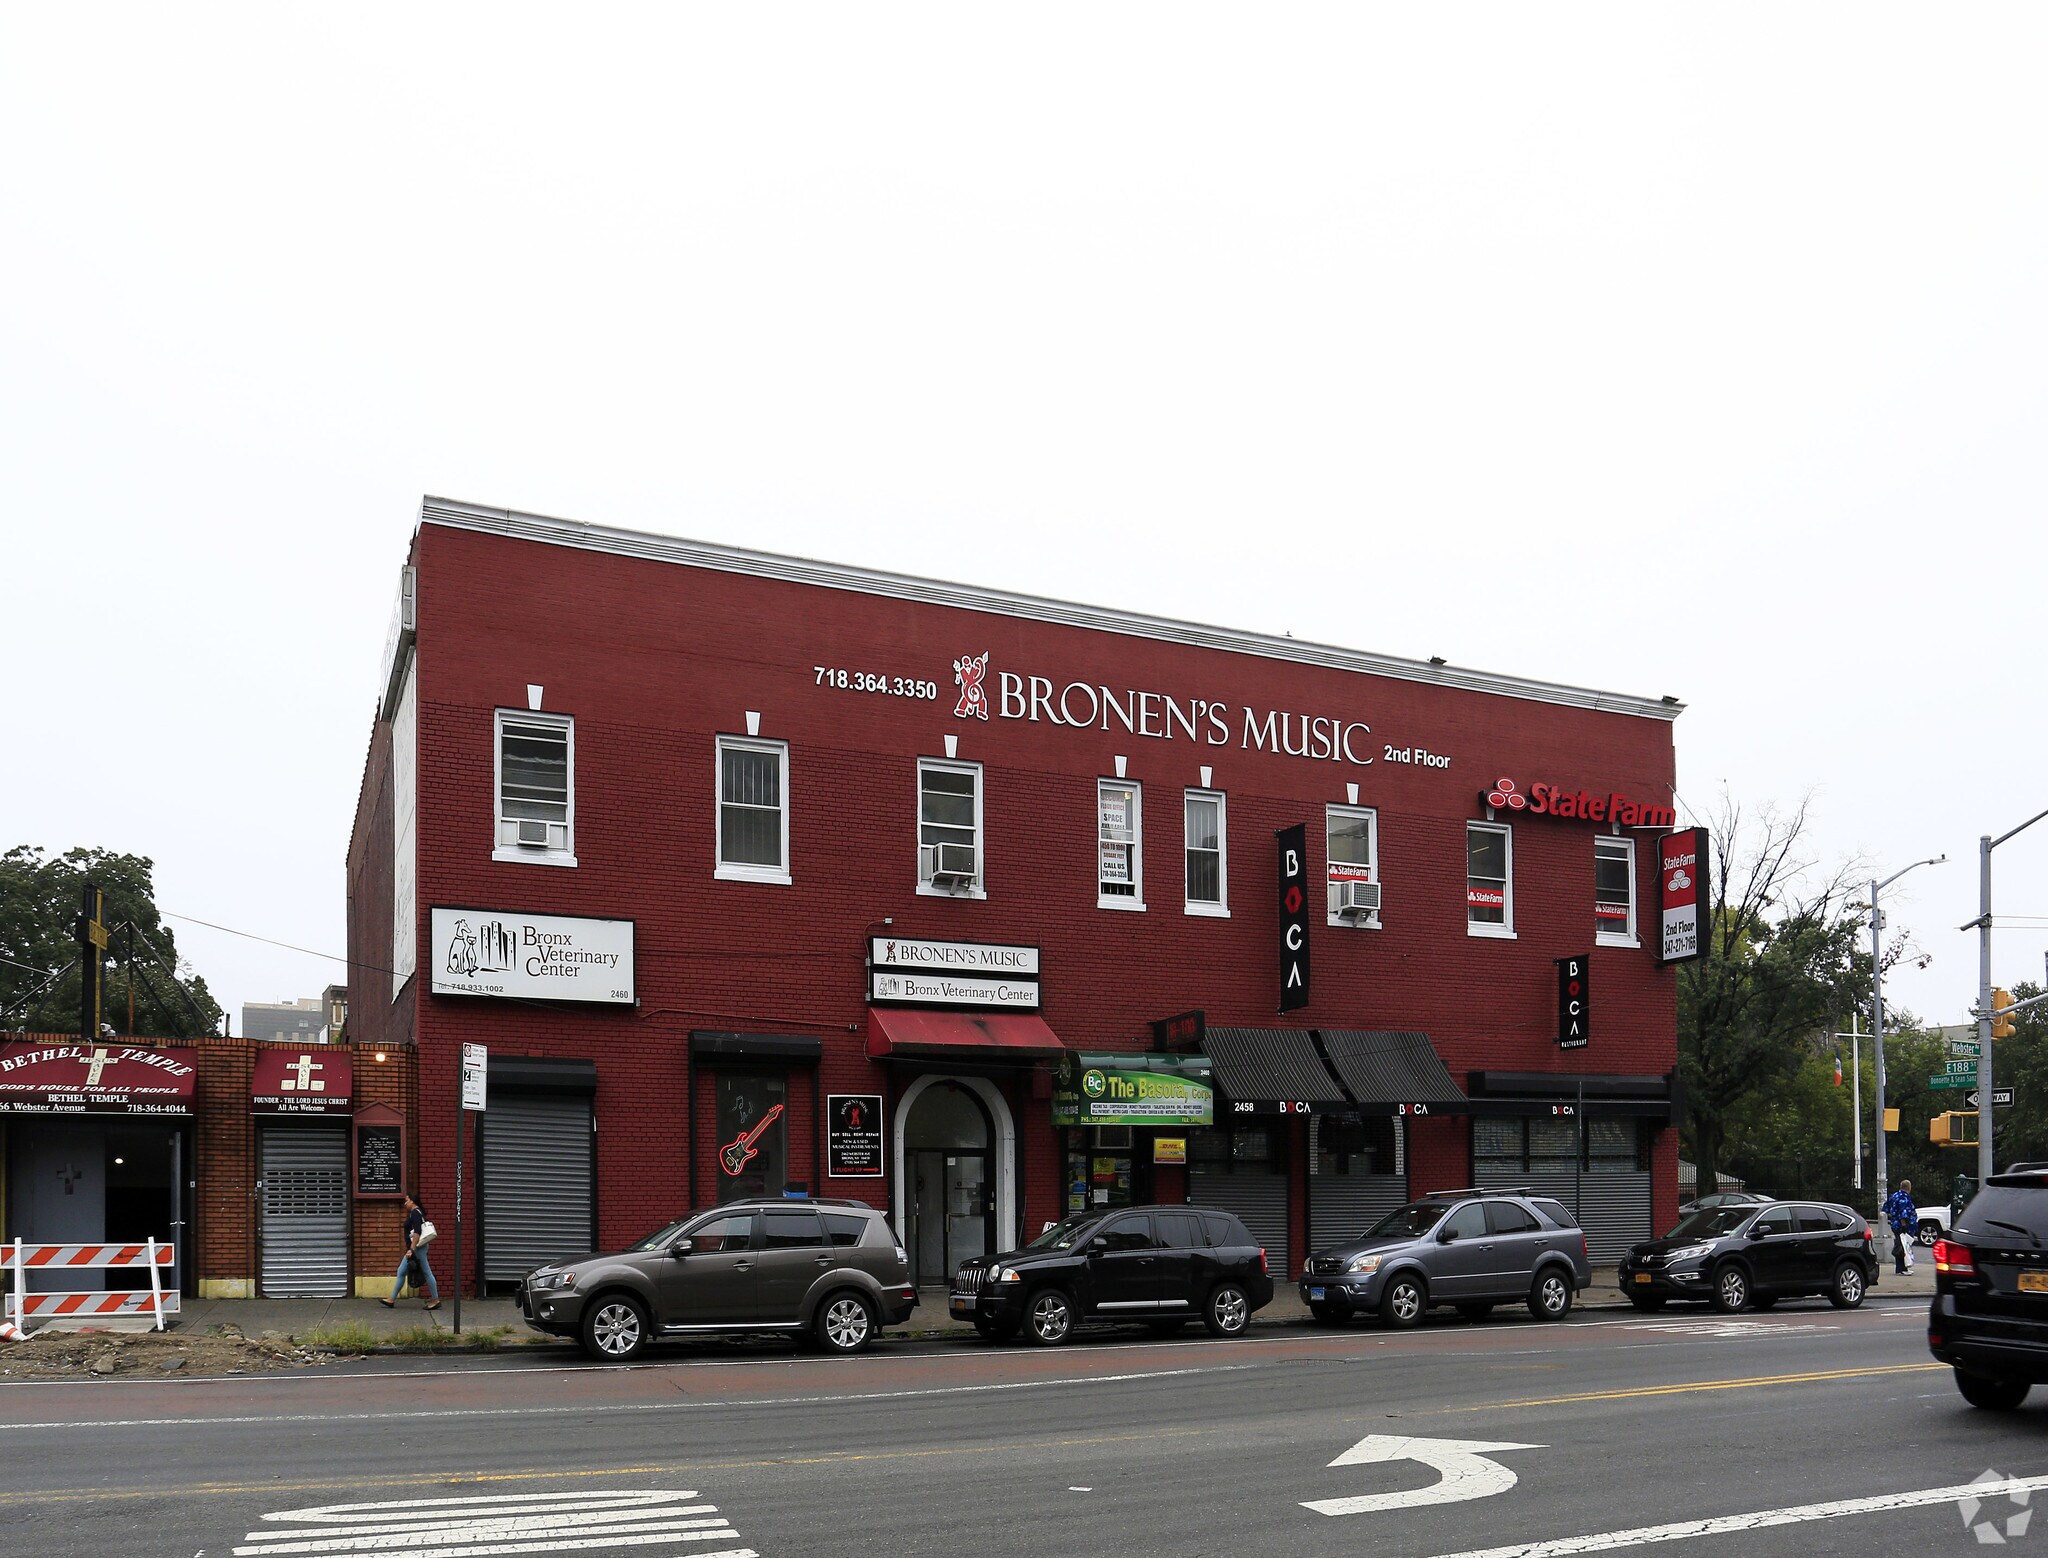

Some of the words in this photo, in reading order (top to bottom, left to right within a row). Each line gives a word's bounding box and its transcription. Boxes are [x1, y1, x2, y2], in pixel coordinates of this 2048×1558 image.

[813, 665, 937, 700] 718.364.3350
[998, 671, 1230, 746] BRONEN'S
[1241, 706, 1374, 766] MUSIC
[1383, 744, 1411, 764] 2nd
[1414, 749, 1451, 769] Floor
[1103, 813, 1123, 822] SPACE
[1666, 922, 1677, 936] 2nd
[1679, 920, 1695, 934] Floor
[522, 925, 573, 946] Bronx
[1665, 936, 1696, 954] 347-271-7166
[538, 944, 619, 969] Veterinary
[900, 945, 976, 964] BRONEN'S
[980, 951, 1028, 967] MUSIC
[525, 956, 581, 978] Center
[452, 983, 504, 993] 718.933.1002
[610, 990, 629, 999] 2460
[904, 980, 940, 996] Bronx
[940, 983, 996, 1002] Veterinary
[997, 985, 1034, 1001] Center
[1952, 1043, 1974, 1054] Webster
[0, 1047, 82, 1071] BETHEL
[119, 1048, 193, 1077] TEMPLE
[1946, 1064, 1951, 1073] E
[1953, 1062, 1969, 1072] 188
[1108, 1077, 1134, 1098] The
[1139, 1078, 1189, 1103] Basora,
[1191, 1088, 1211, 1102] Corp.
[48, 1094, 86, 1102] BETHEL
[90, 1095, 128, 1103] TEMPLE
[13, 1103, 50, 1111] Webster
[53, 1104, 86, 1112] Avenue
[127, 1104, 187, 1113] 718-364-4044
[1234, 1102, 1254, 1112] 2458
[1279, 1101, 1311, 1113] BOCA
[1399, 1103, 1428, 1115] BOCA
[1552, 1106, 1574, 1115] BOCA
